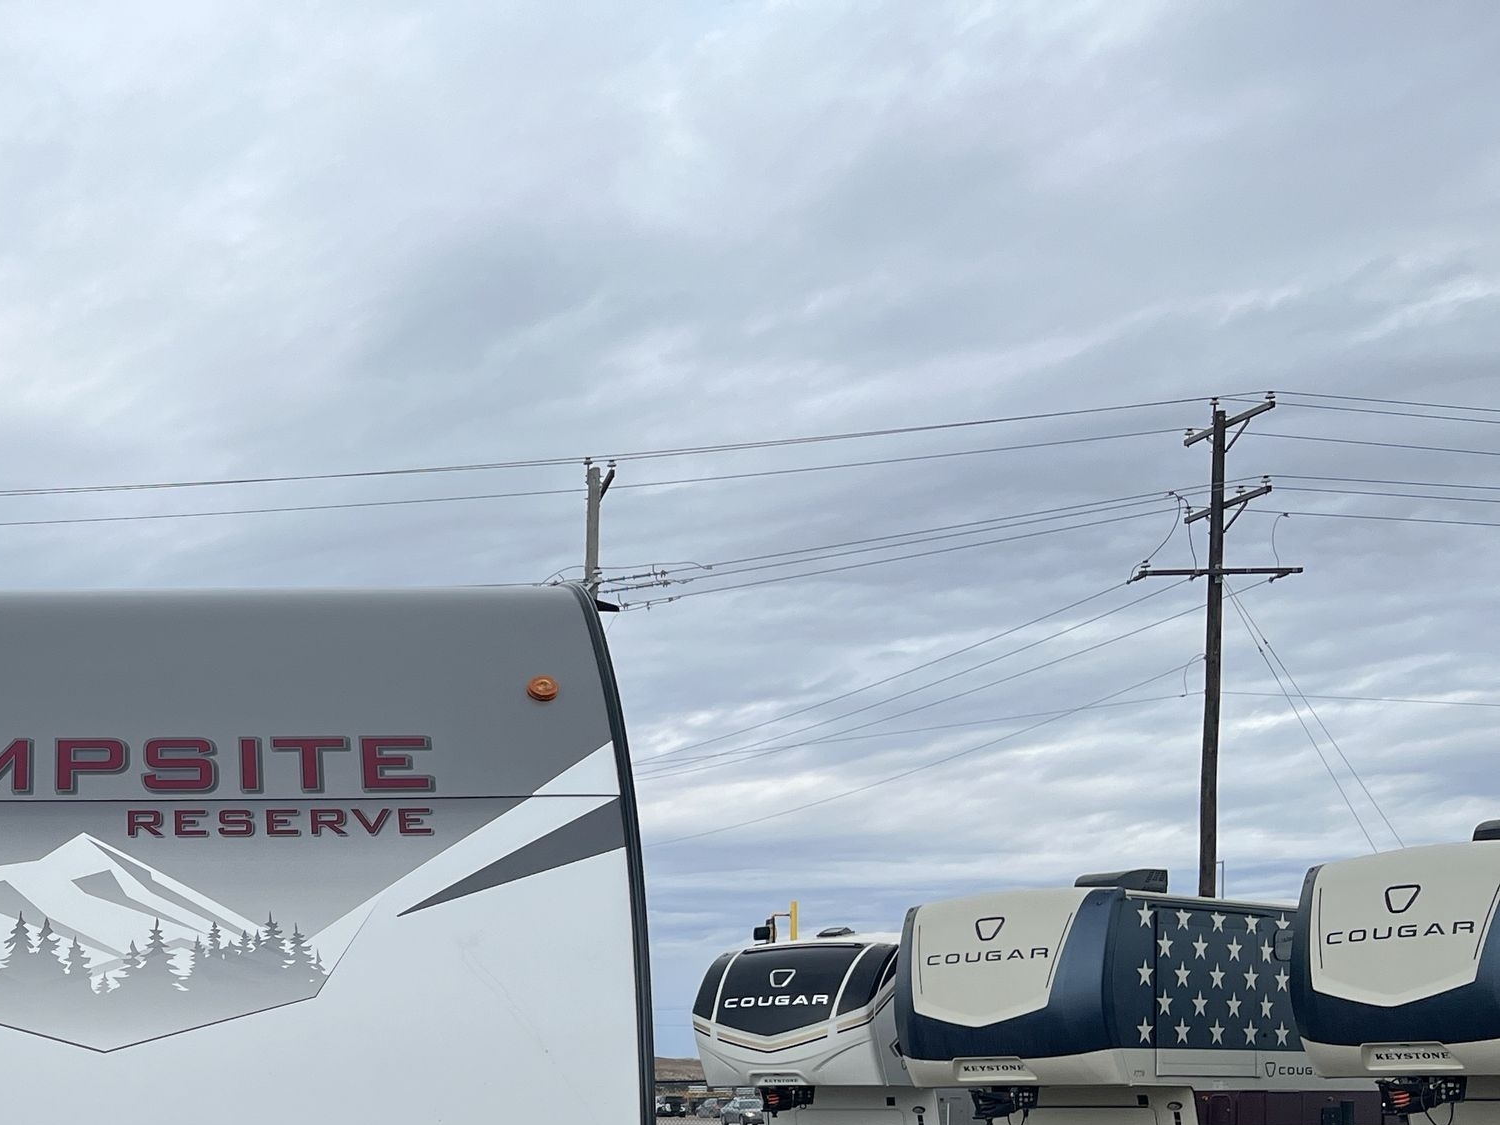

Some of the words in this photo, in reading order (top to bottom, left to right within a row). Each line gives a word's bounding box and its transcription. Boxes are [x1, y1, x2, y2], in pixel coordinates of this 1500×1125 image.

[126, 807, 435, 838] RESERVE
[1326, 920, 1475, 945] COUGAR
[926, 947, 1049, 966] COUGAR
[724, 994, 829, 1009] COUGAR
[1375, 1051, 1451, 1061] KEYSTONE
[963, 1064, 1026, 1072] KEYSTONE
[1278, 1066, 1317, 1076] COUG
